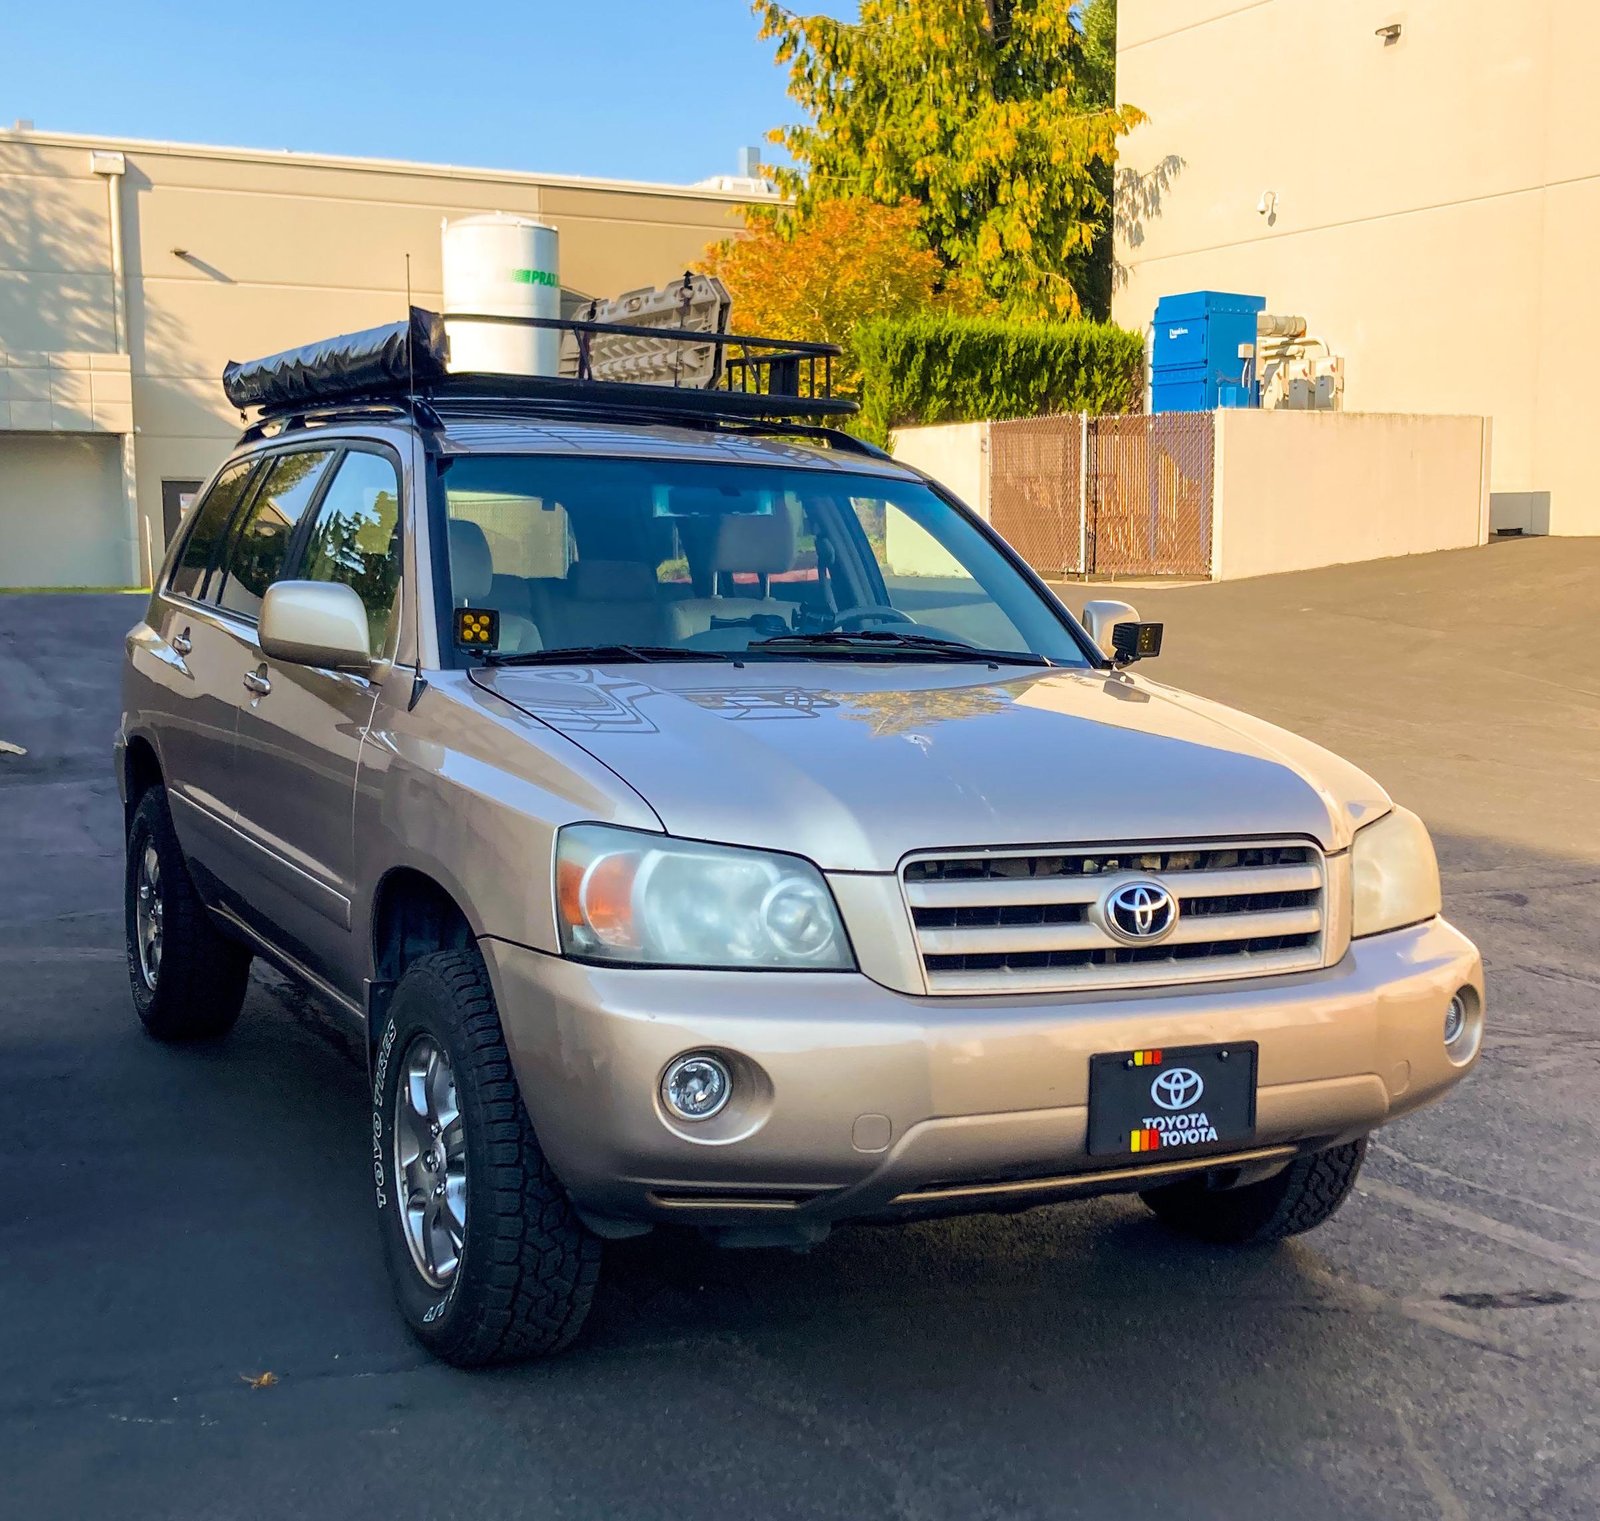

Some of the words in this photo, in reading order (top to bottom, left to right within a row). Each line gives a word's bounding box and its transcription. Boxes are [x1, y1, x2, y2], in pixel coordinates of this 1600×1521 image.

[374, 1018, 397, 1107] TIRES
[1142, 1112, 1209, 1131] TOYOTA
[1160, 1126, 1219, 1147] TOYOTA
[372, 1111, 387, 1209] TOYO
